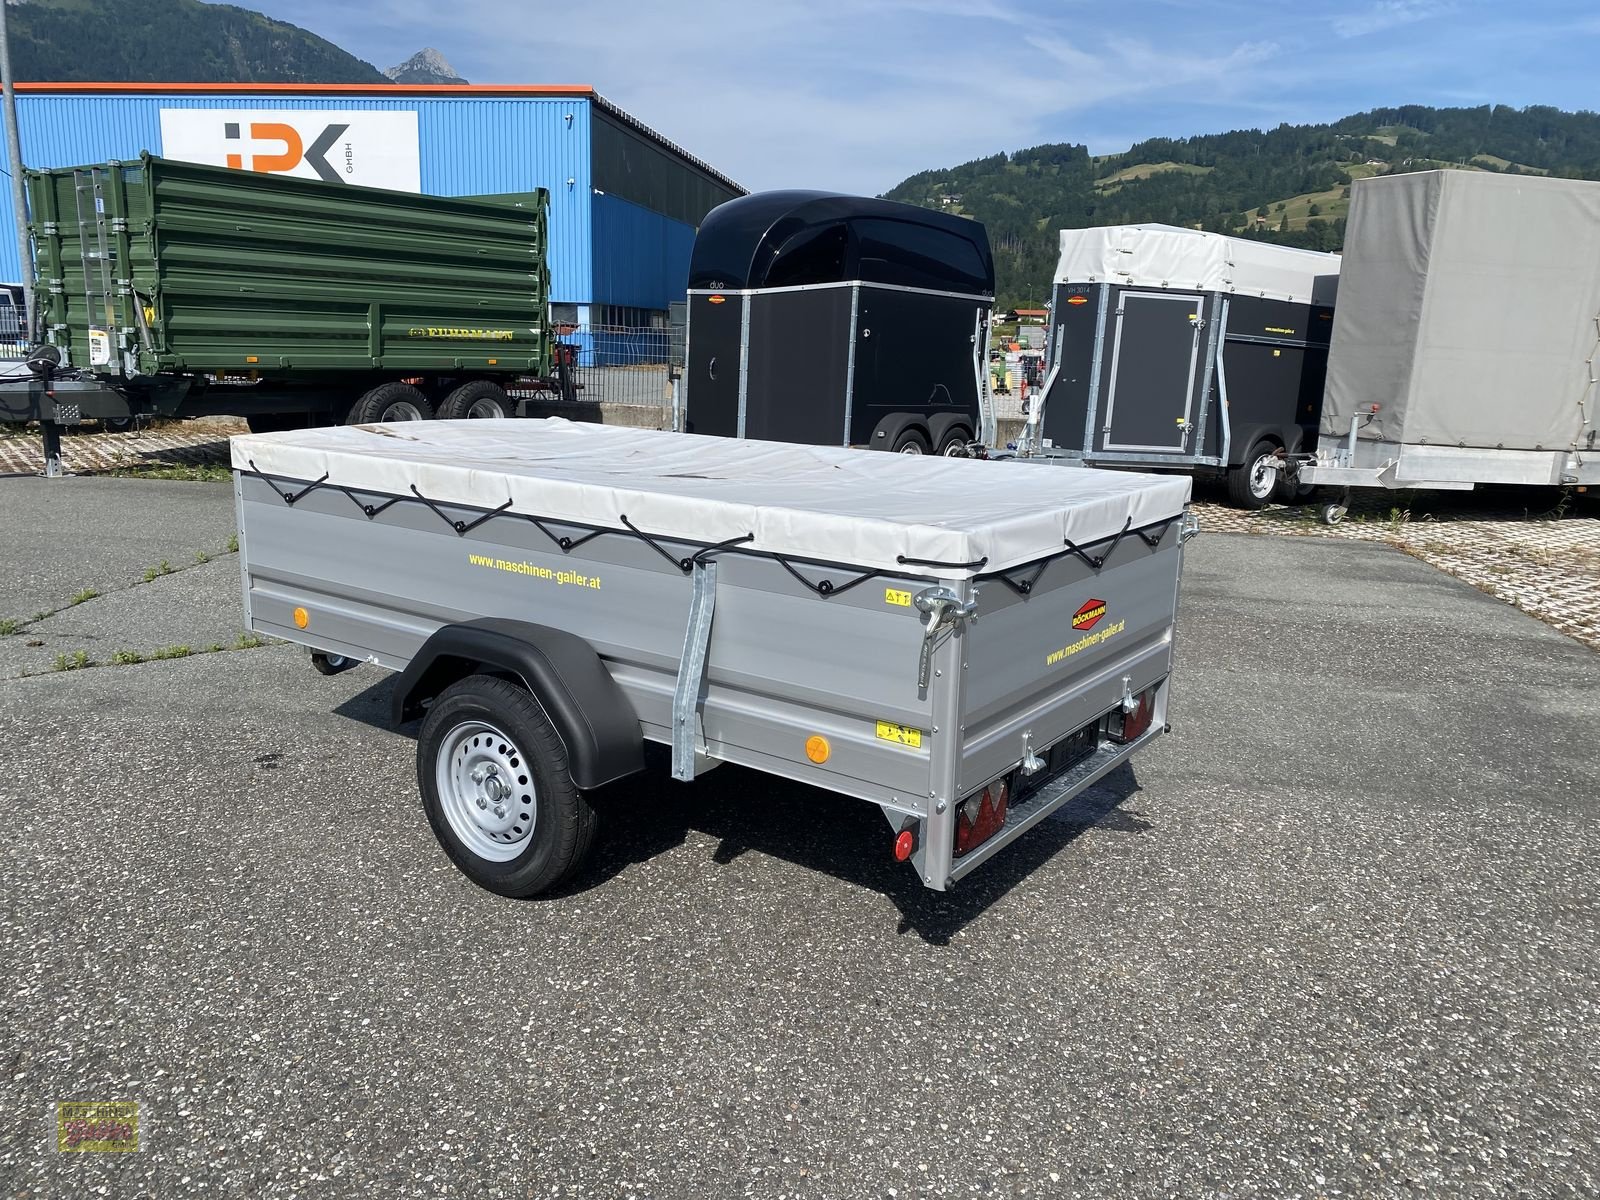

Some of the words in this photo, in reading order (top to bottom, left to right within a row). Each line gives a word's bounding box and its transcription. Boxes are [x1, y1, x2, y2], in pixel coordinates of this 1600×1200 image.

[345, 143, 353, 173] GMBH
[710, 280, 724, 289] duo
[469, 553, 601, 590] www.maschinen-gailer.at
[1072, 604, 1106, 627] BÖCKMANN
[1046, 618, 1125, 666] www.maschinen-gailer.at
